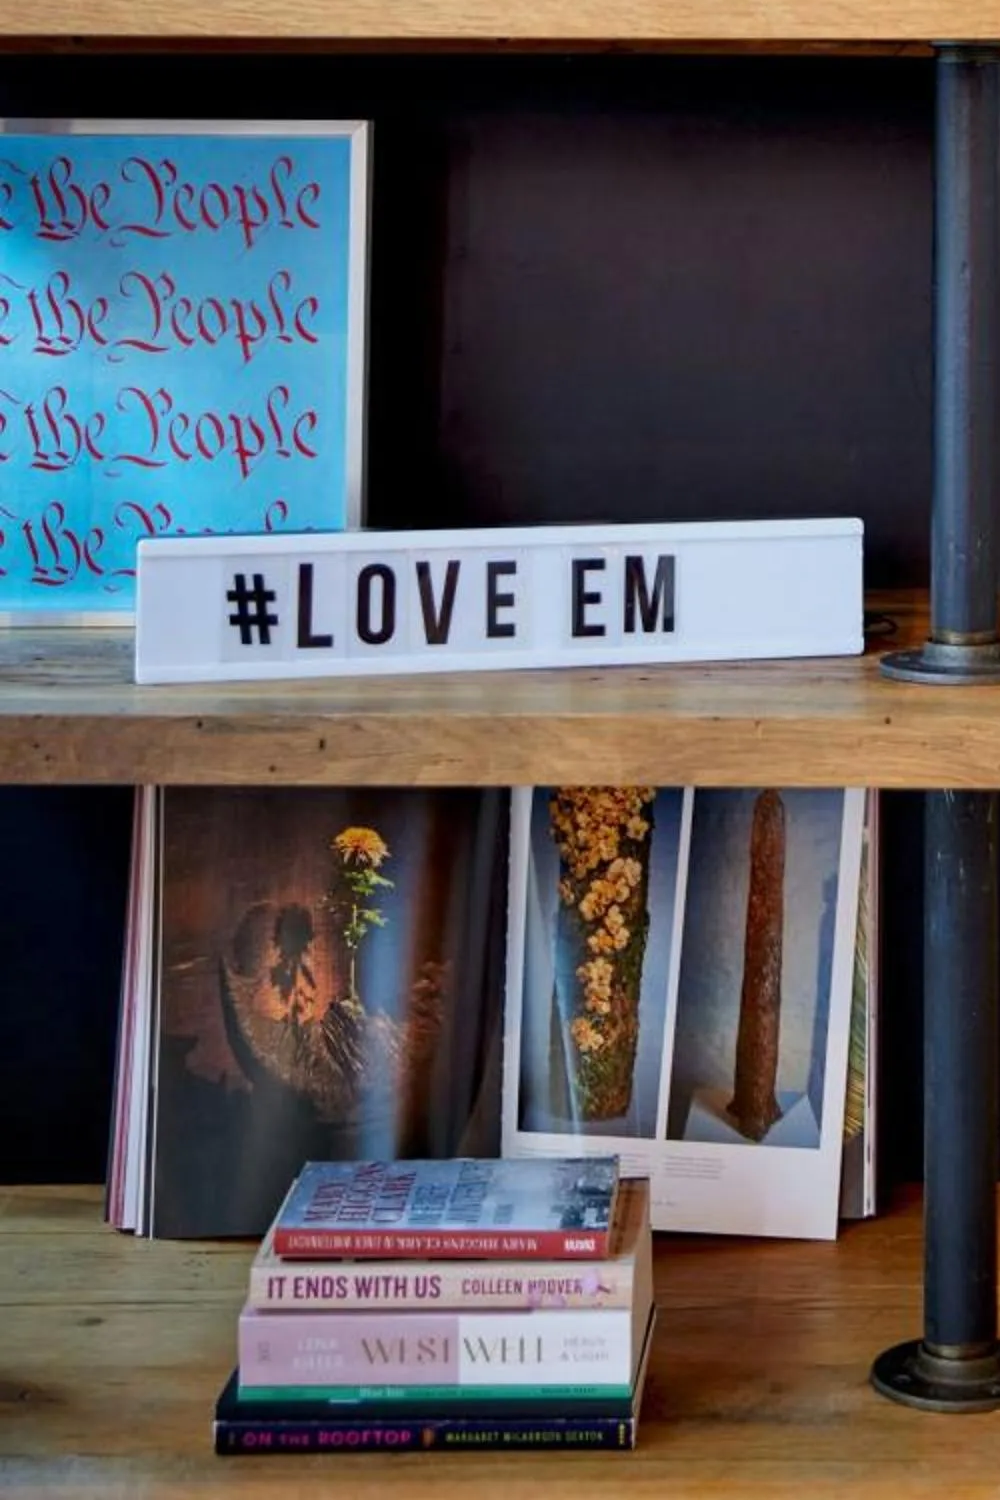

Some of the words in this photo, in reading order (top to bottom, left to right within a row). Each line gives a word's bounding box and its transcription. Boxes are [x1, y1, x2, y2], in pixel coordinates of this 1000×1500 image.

[112, 155, 322, 249] People
[109, 270, 320, 363] People
[106, 385, 319, 480] People
[571, 553, 677, 639] EM
[267, 1275, 286, 1300] IT
[293, 1275, 348, 1299] ENDS
[353, 1275, 408, 1299] WITH
[414, 1275, 442, 1298] US
[461, 1278, 522, 1295] COLLEEN
[527, 1278, 583, 1295] HOOVER
[317, 1430, 412, 1445] ROOFTOP
